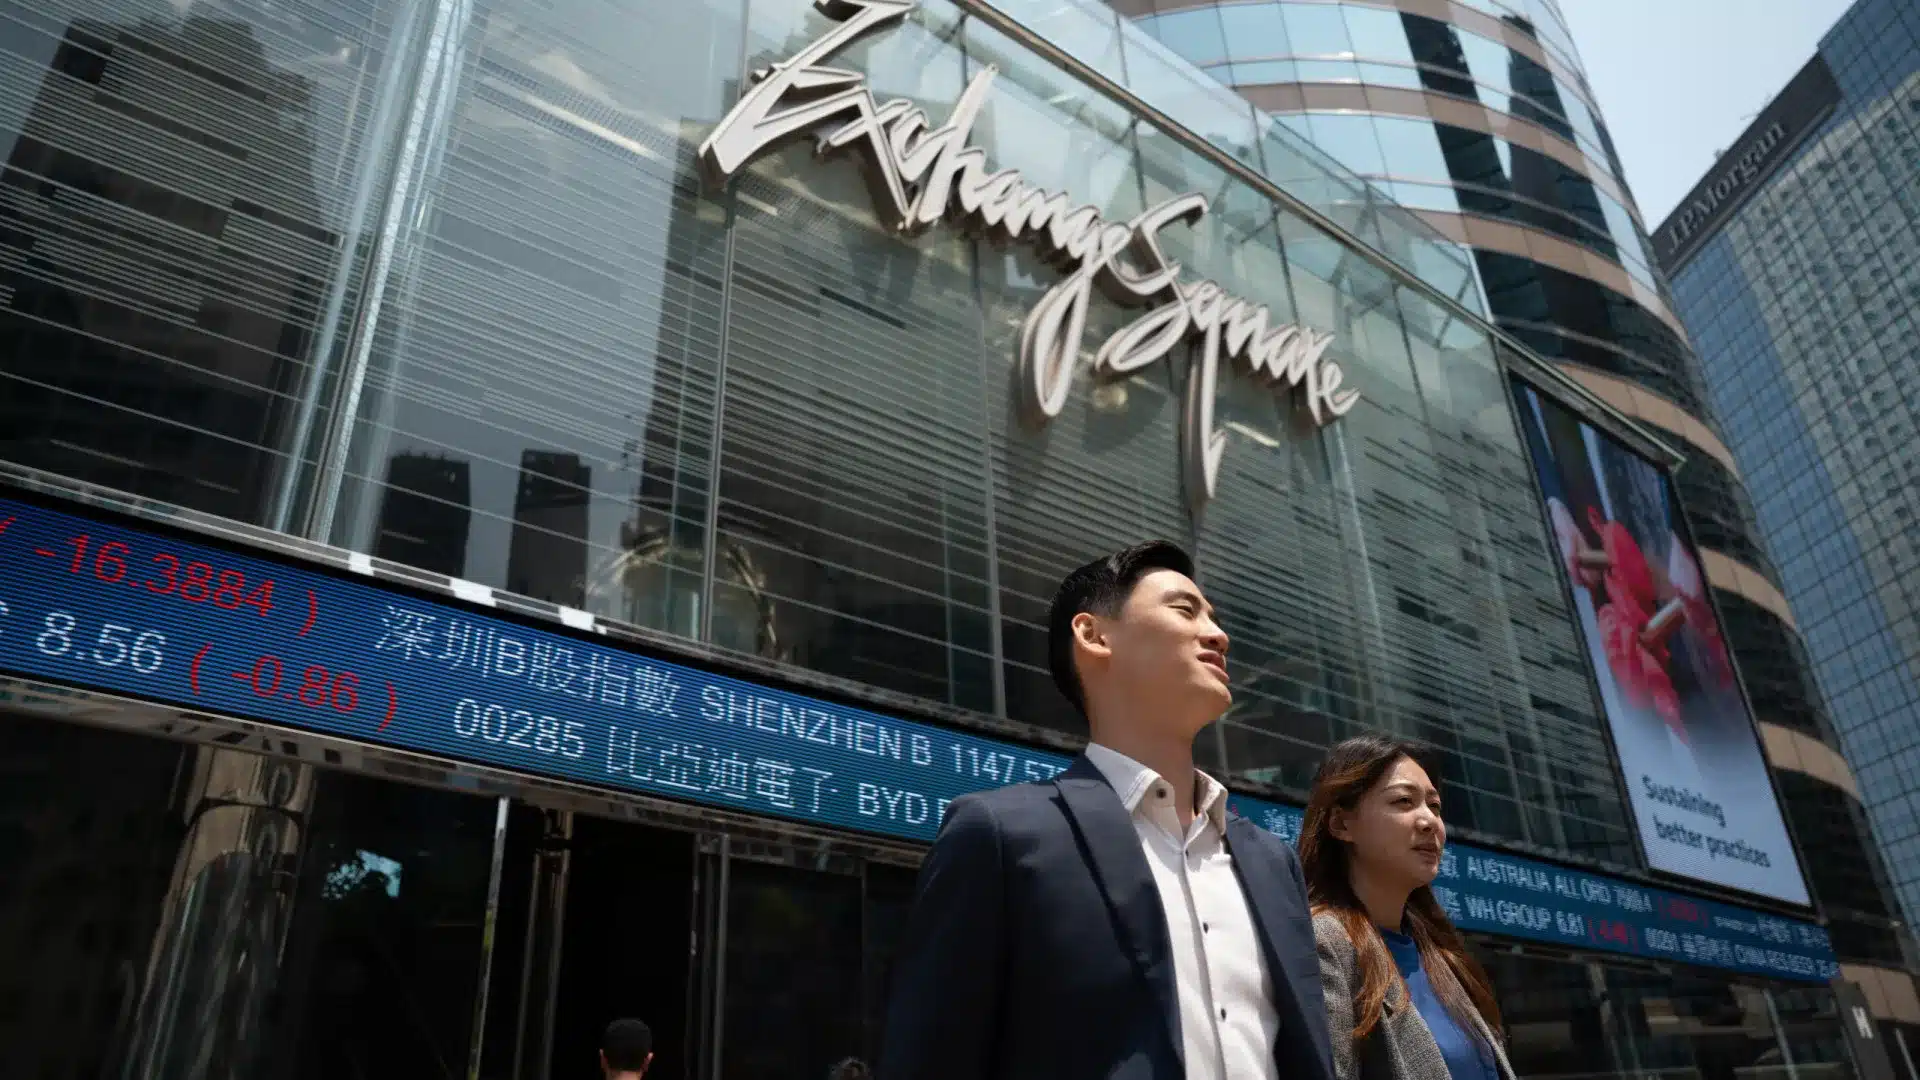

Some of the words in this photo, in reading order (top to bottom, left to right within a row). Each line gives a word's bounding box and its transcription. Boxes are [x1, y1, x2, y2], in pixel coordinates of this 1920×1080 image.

[699, 0, 1180, 417] Exchange
[1097, 192, 1361, 499] Square
[34, 533, 275, 618] -16.3884
[36, 609, 167, 674] 8.56
[231, 654, 361, 713] -0.86
[453, 698, 586, 758] 00285
[857, 782, 929, 825] BYD
[699, 684, 900, 761] SHENZHEN
[911, 733, 933, 766] B
[1641, 773, 1727, 828] Sustaining
[1653, 812, 1703, 849] better
[1705, 835, 1771, 868] practices
[1463, 893, 1496, 921] WH
[1496, 900, 1552, 931] GROUP
[1467, 856, 1552, 893] AUSTRALIA
[1554, 875, 1581, 900] ALL
